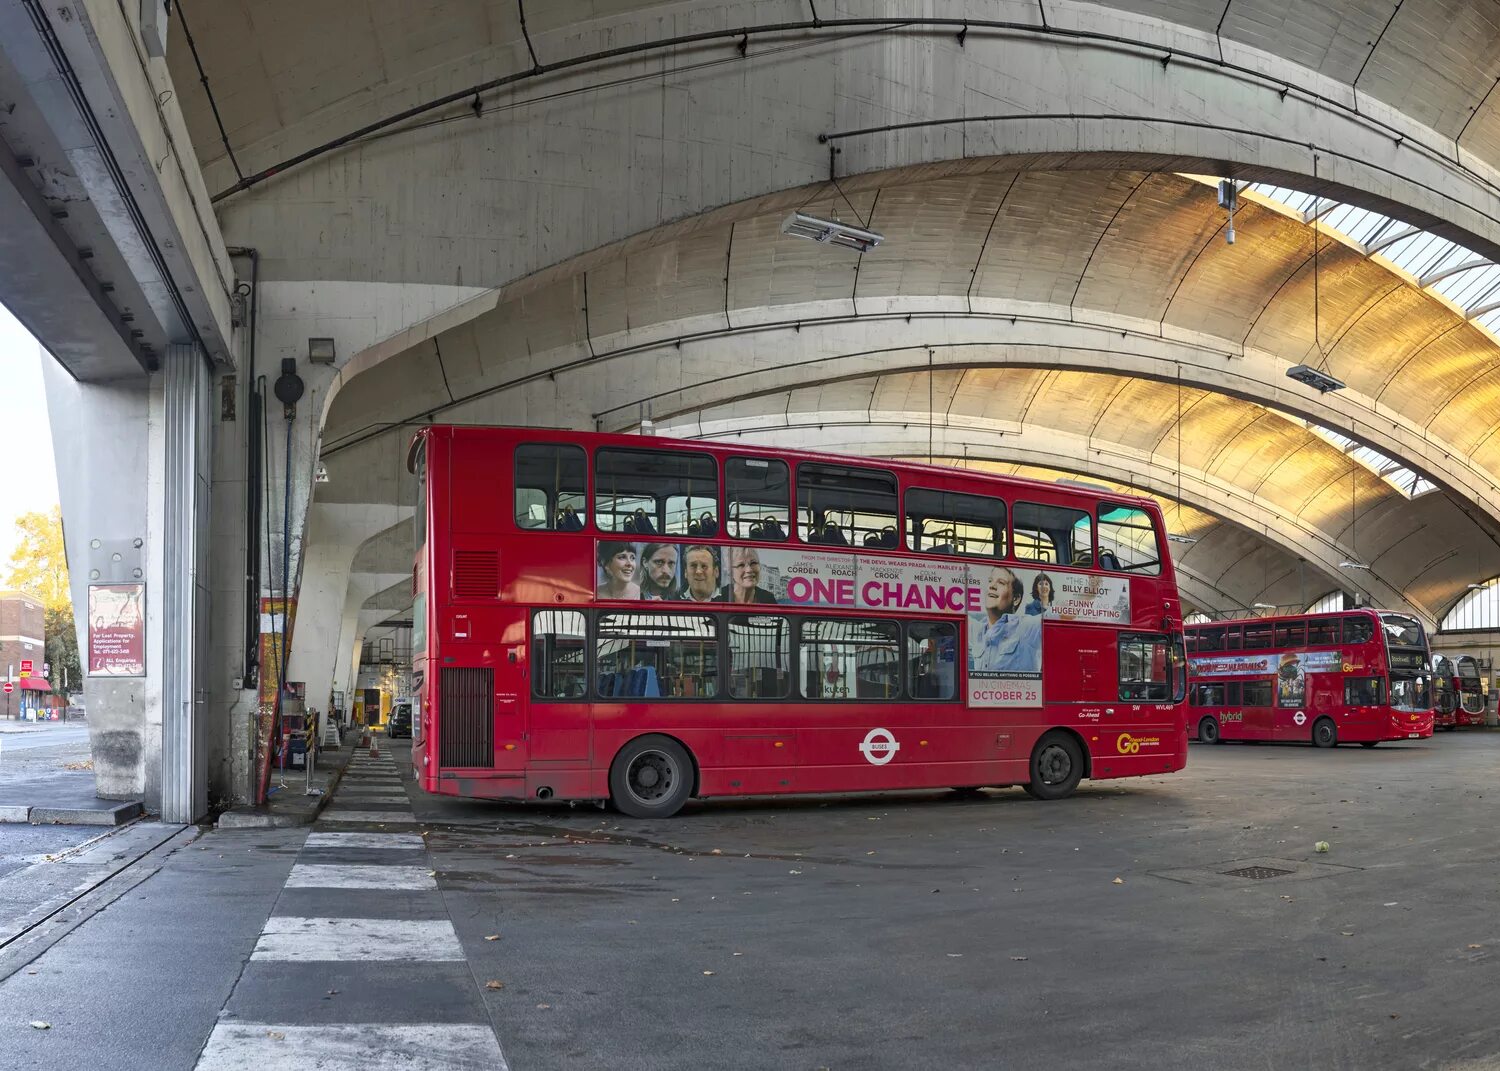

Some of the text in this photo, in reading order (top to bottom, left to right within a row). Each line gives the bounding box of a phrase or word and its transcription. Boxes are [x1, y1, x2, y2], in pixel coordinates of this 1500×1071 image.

[787, 566, 981, 585] CORDEN ROACH CROOK MEANEY WALTERS
[787, 576, 982, 612] ONE CHANCE
[1062, 584, 1082, 593] BILLY
[1069, 600, 1094, 608] FUNNY
[1051, 607, 1081, 616] HUGELY
[1082, 609, 1120, 618] UPLIFTING
[991, 681, 1031, 690] CINEMAS
[973, 691, 1037, 700] OCTOBER 25
[1220, 711, 1242, 723] hybrid
[1117, 733, 1139, 754] Go
